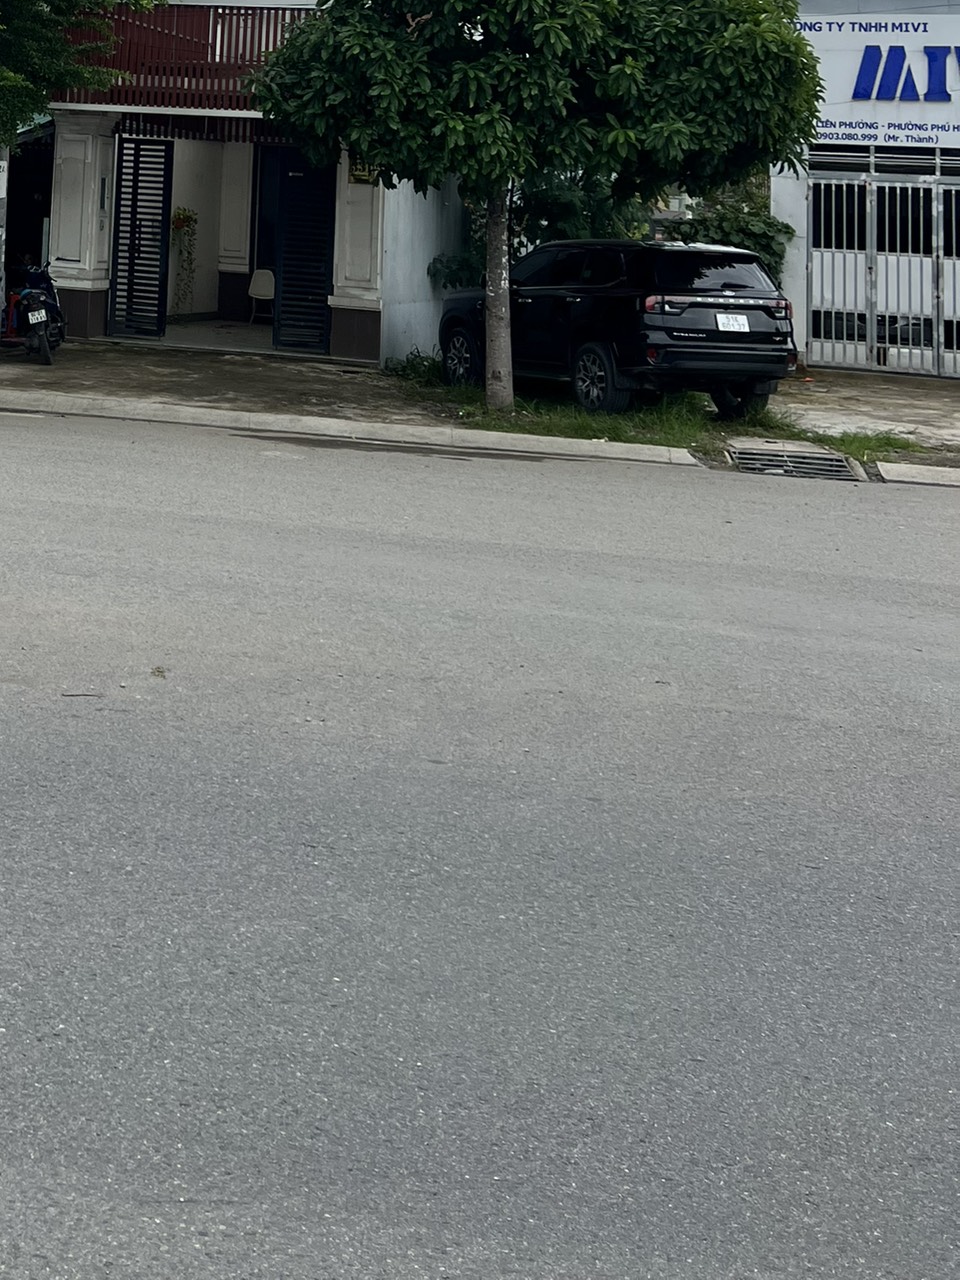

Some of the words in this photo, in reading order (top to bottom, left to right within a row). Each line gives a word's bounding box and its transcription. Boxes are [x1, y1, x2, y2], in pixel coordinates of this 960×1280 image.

[825, 22, 845, 32] TY
[849, 22, 888, 33] TNHH
[891, 23, 928, 33] MIVI
[931, 122, 950, 132] PHÚ
